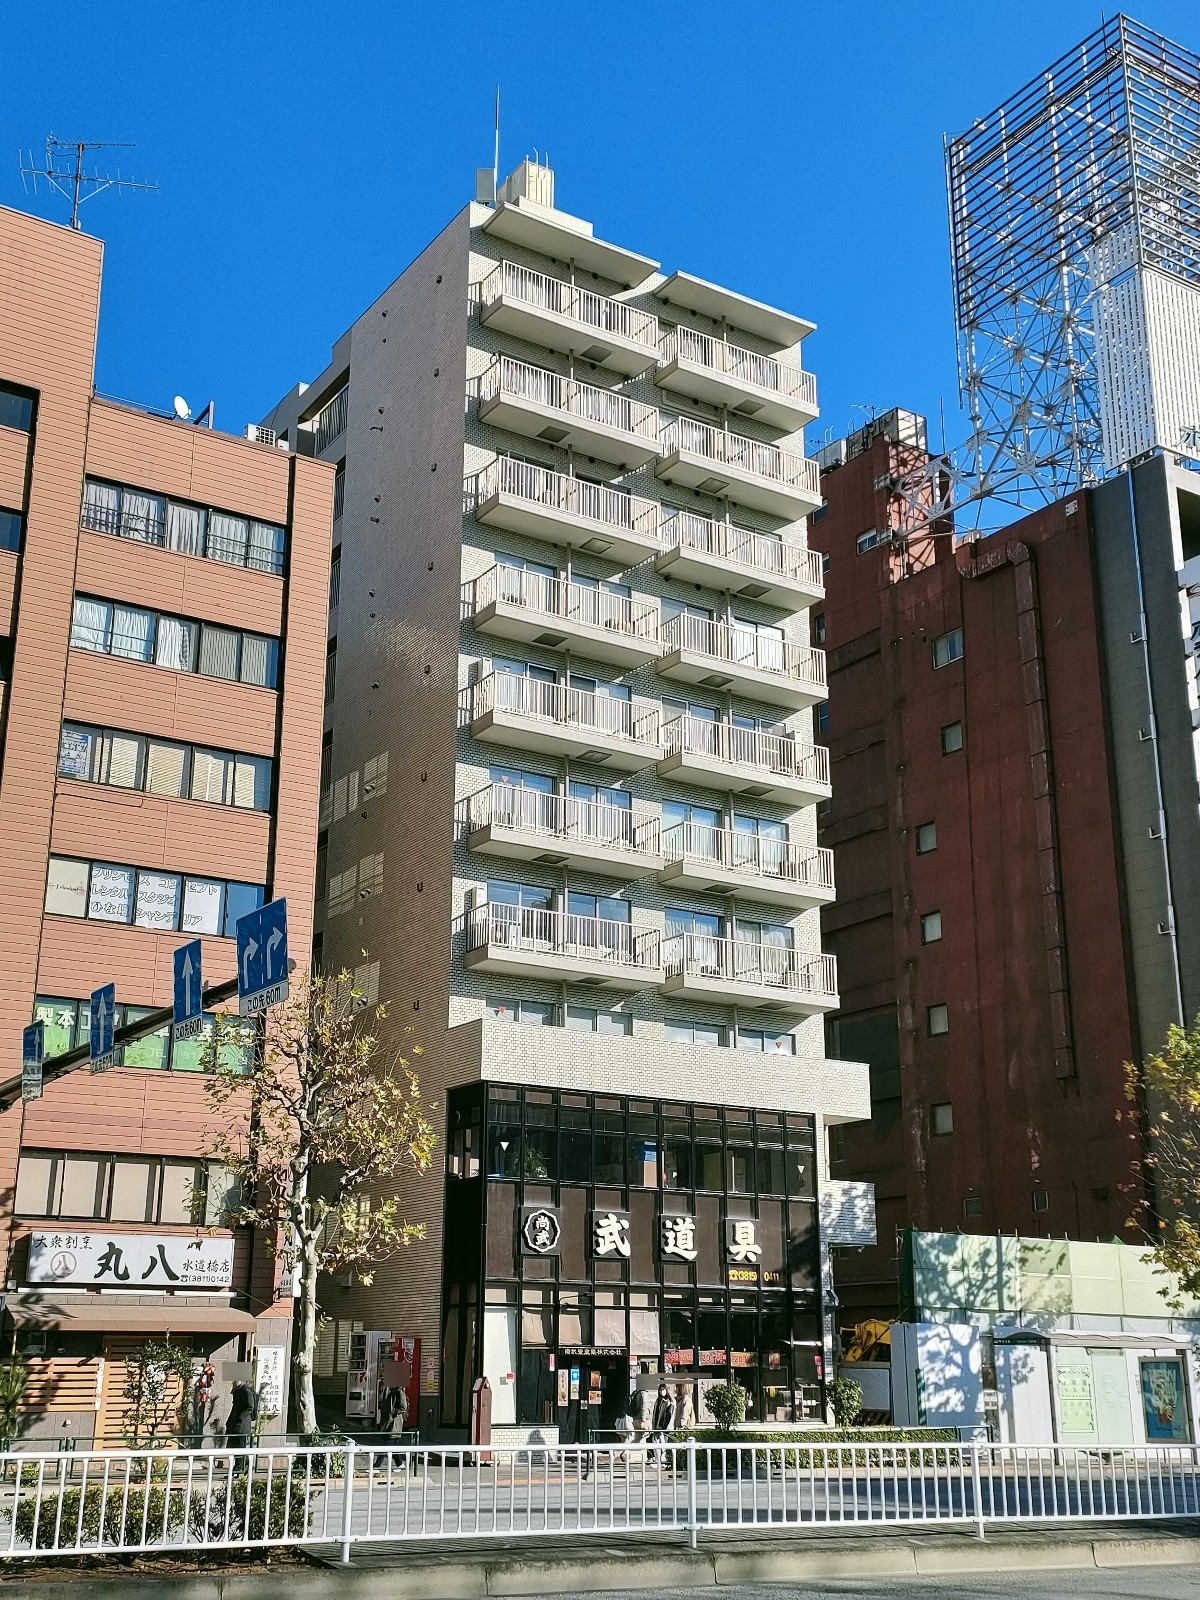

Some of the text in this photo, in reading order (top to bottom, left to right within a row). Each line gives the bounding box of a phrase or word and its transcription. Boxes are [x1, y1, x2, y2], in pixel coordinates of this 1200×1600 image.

[247, 986, 281, 1012] この先60m
[175, 1017, 203, 1040] この先60m
[594, 1213, 763, 1263] 武道具
[94, 1241, 181, 1281] 丸八
[182, 1258, 230, 1273] 水道橋店
